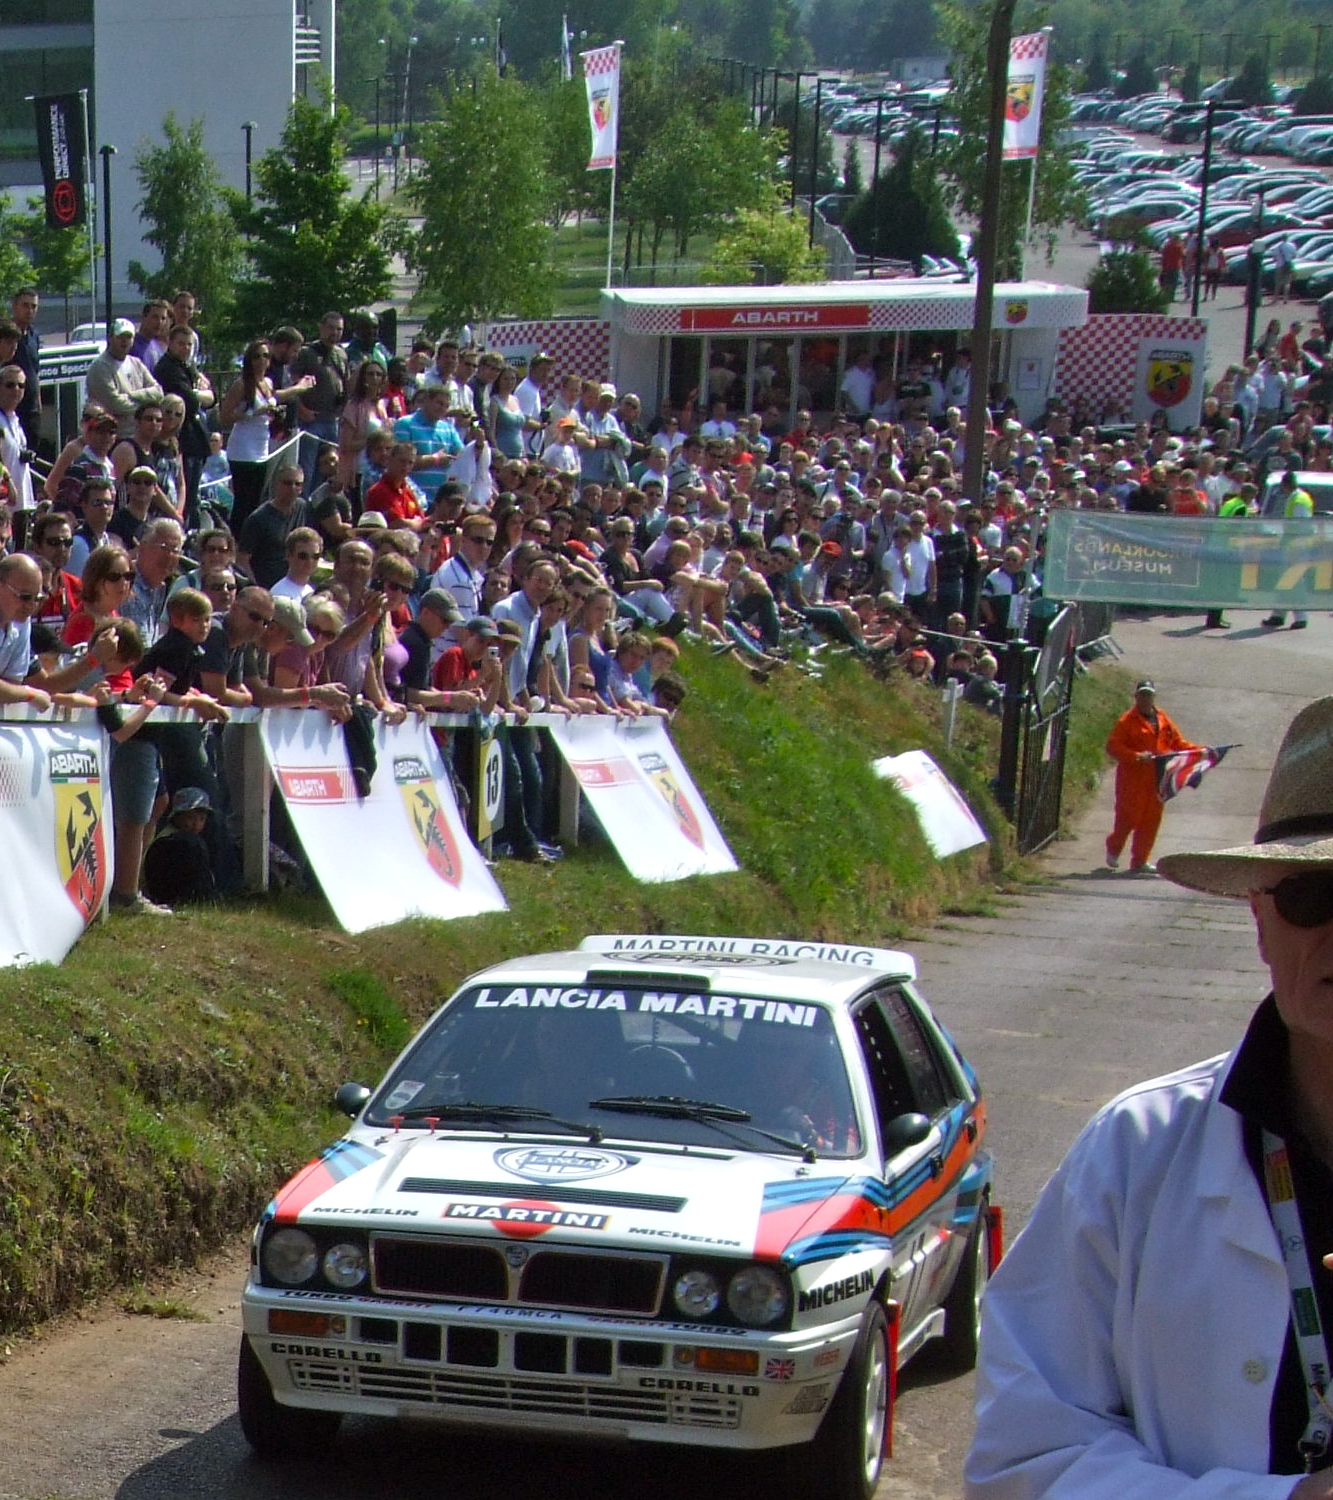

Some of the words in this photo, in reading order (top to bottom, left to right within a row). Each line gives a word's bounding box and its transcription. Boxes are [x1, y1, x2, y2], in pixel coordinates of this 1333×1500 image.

[731, 309, 819, 325] ABARTH
[50, 753, 100, 775] ABARTH
[394, 761, 431, 780] ABARTH
[287, 777, 327, 797] ABARTH
[485, 753, 499, 808] 13
[612, 938, 735, 955] MARTINI
[751, 942, 875, 966] RACING
[474, 987, 627, 1011] LANCIA
[639, 991, 818, 1028] MARTINI
[312, 1205, 421, 1218] MICHELIN
[448, 1203, 605, 1228] MARTINI
[627, 1226, 742, 1247] MICHELIN
[798, 1268, 874, 1313] MICHELIN
[270, 1342, 382, 1363] CARELLO
[638, 1376, 760, 1397] CARELLO
